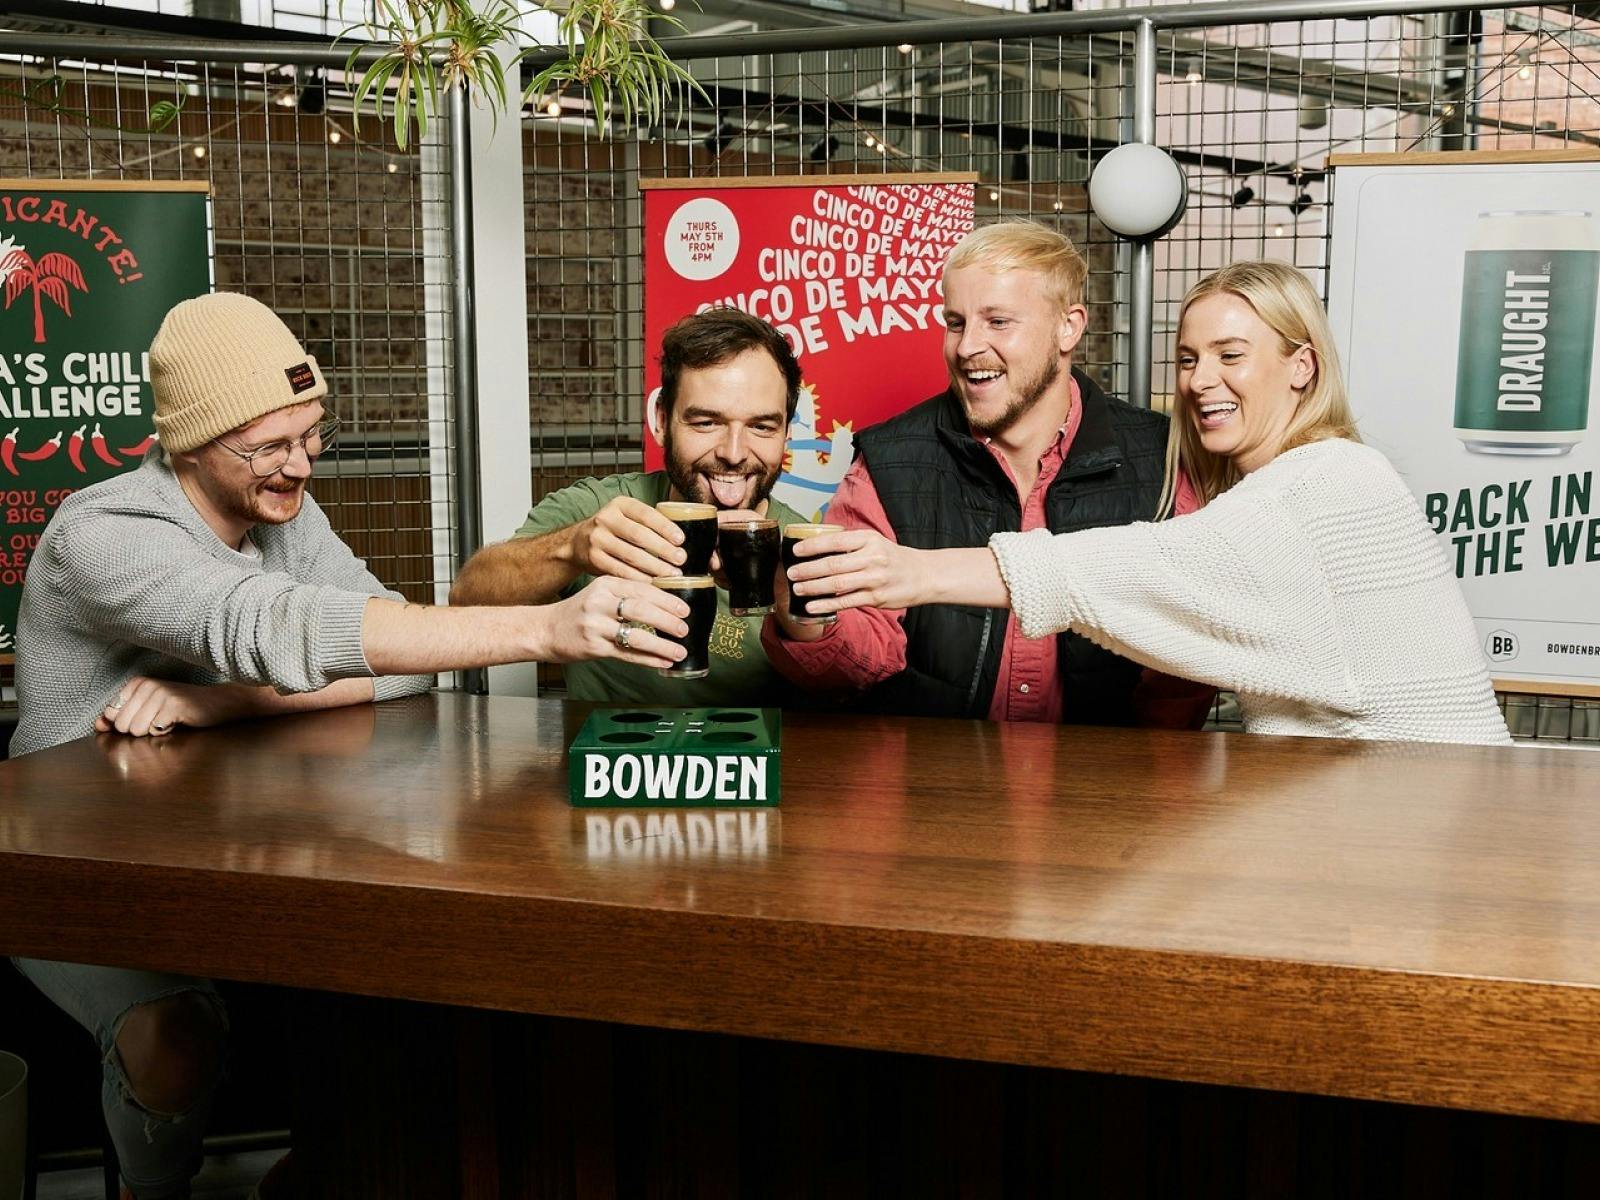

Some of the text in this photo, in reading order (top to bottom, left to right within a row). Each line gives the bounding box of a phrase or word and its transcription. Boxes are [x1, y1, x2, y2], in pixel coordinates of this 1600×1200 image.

[847, 185, 974, 231] CINCO DE MAYO
[921, 195, 939, 211] DE
[940, 203, 975, 219] MAYO
[933, 187, 948, 200] DE
[687, 222, 717, 231] THURS
[813, 189, 969, 244] CINCO DE MAYO
[681, 232, 724, 241] MAY 5TH
[688, 243, 715, 252] FROM
[791, 214, 952, 259] CINCO DE MAY
[692, 253, 712, 262] 4PM
[758, 248, 944, 283] CINCO DE MAY
[804, 278, 846, 315] DE
[858, 277, 944, 304] MAY
[1497, 270, 1551, 412] DRAUGHT
[6, 507, 46, 524] BIG
[1425, 471, 1593, 535] BACK IN
[1452, 528, 1526, 579] THE
[1492, 636, 1514, 656] BB
[584, 753, 768, 801] BOWDEN
